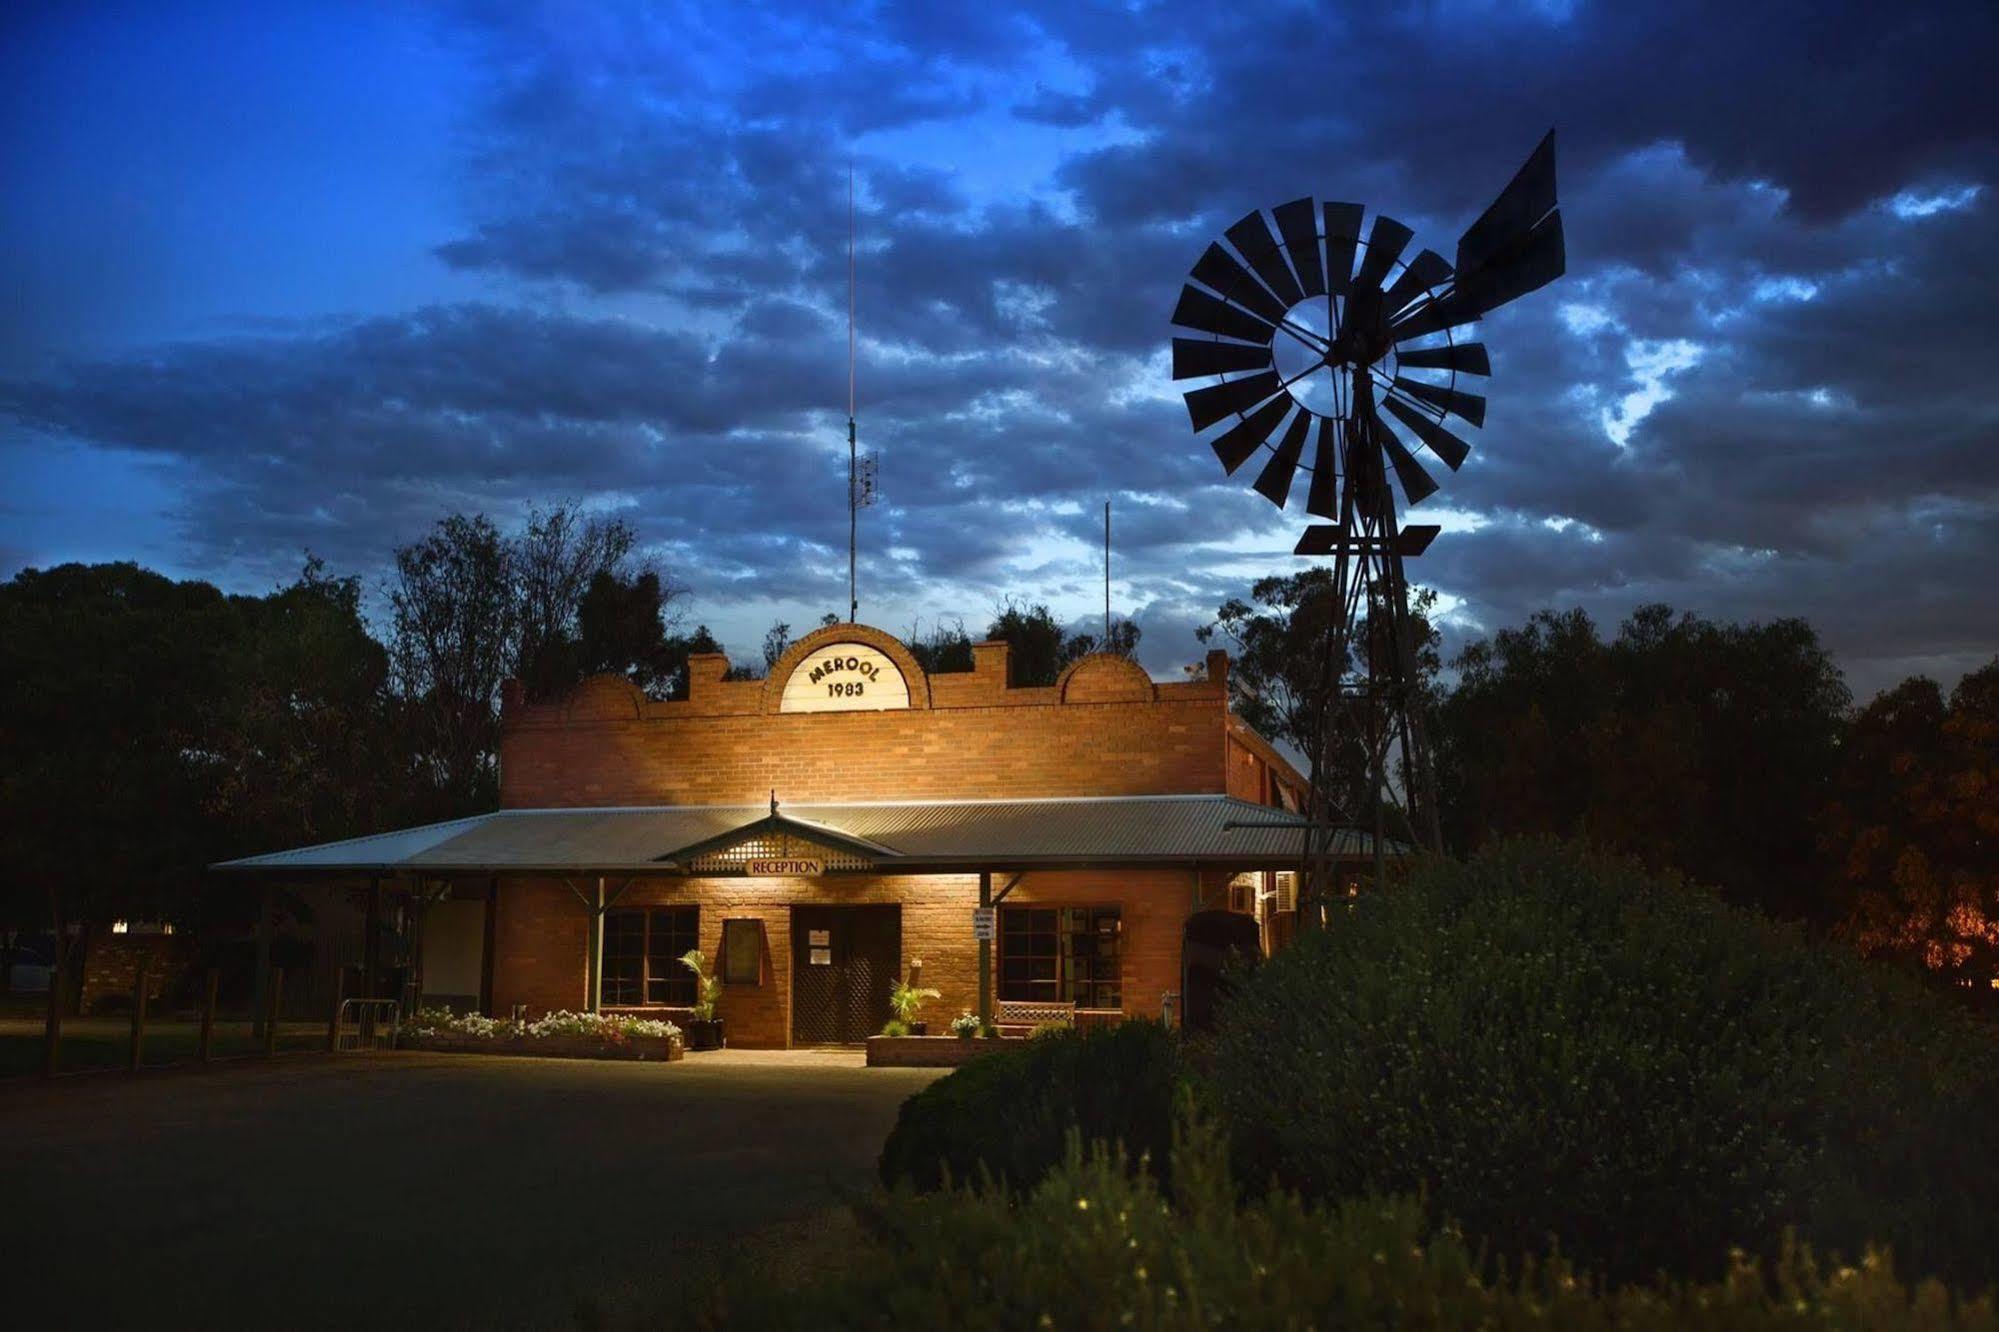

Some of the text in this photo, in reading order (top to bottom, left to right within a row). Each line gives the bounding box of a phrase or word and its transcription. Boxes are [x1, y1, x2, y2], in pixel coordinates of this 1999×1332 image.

[809, 657, 880, 684] MEROOL
[828, 682, 863, 697] 1983
[753, 861, 818, 873] RECEPTION
